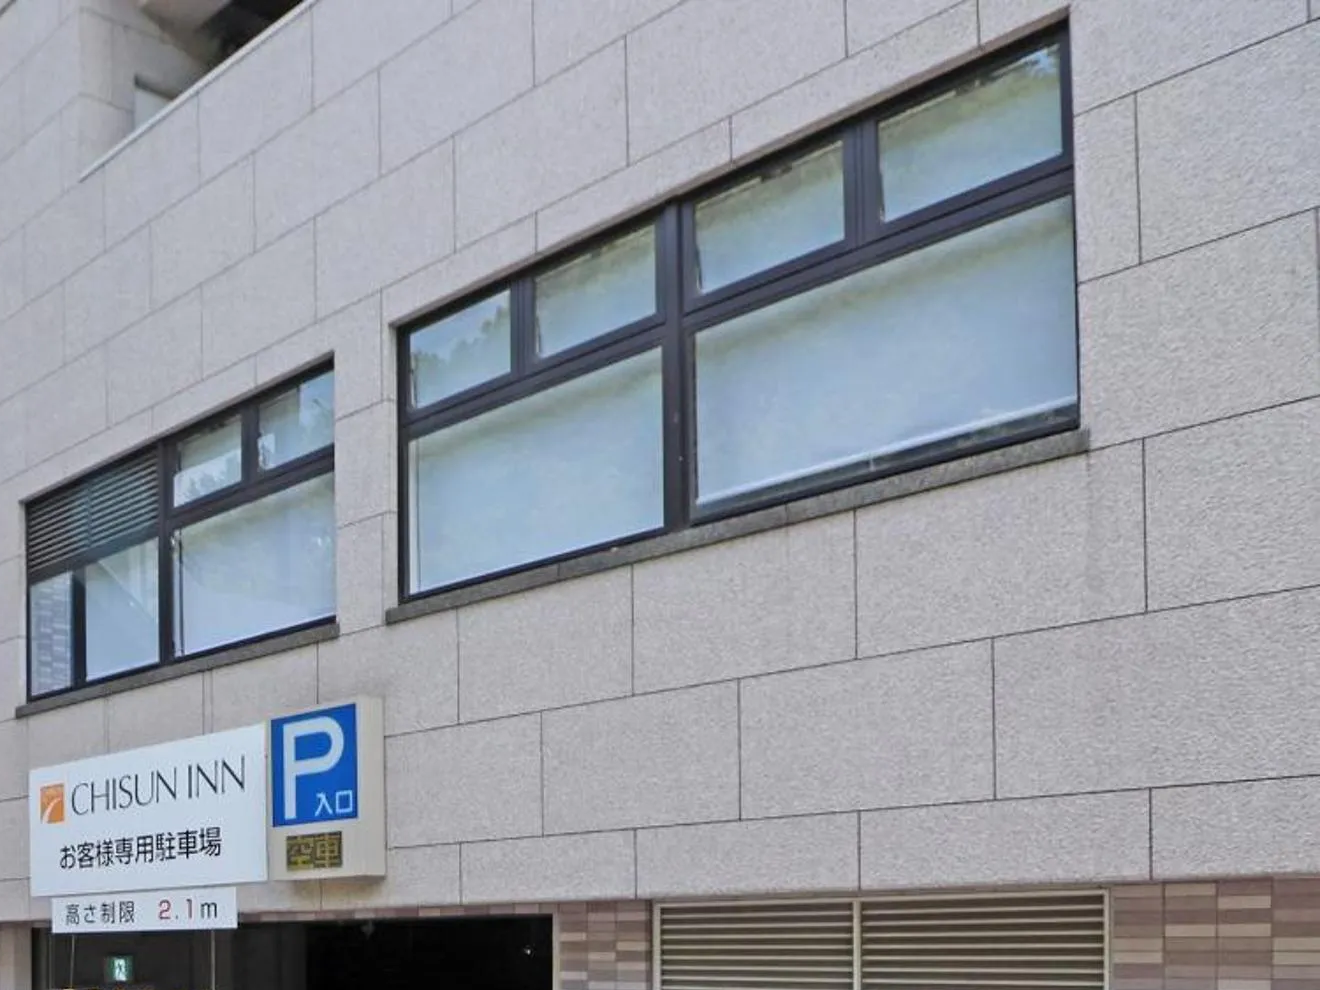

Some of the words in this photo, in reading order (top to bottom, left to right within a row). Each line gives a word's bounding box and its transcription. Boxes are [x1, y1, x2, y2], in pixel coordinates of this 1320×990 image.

[71, 767, 178, 816] CHISUN
[187, 754, 246, 799] INN
[282, 716, 345, 820] P
[314, 789, 354, 817] 入口
[59, 826, 222, 870] お客様専用駐車場
[65, 900, 135, 926] 高さ制限
